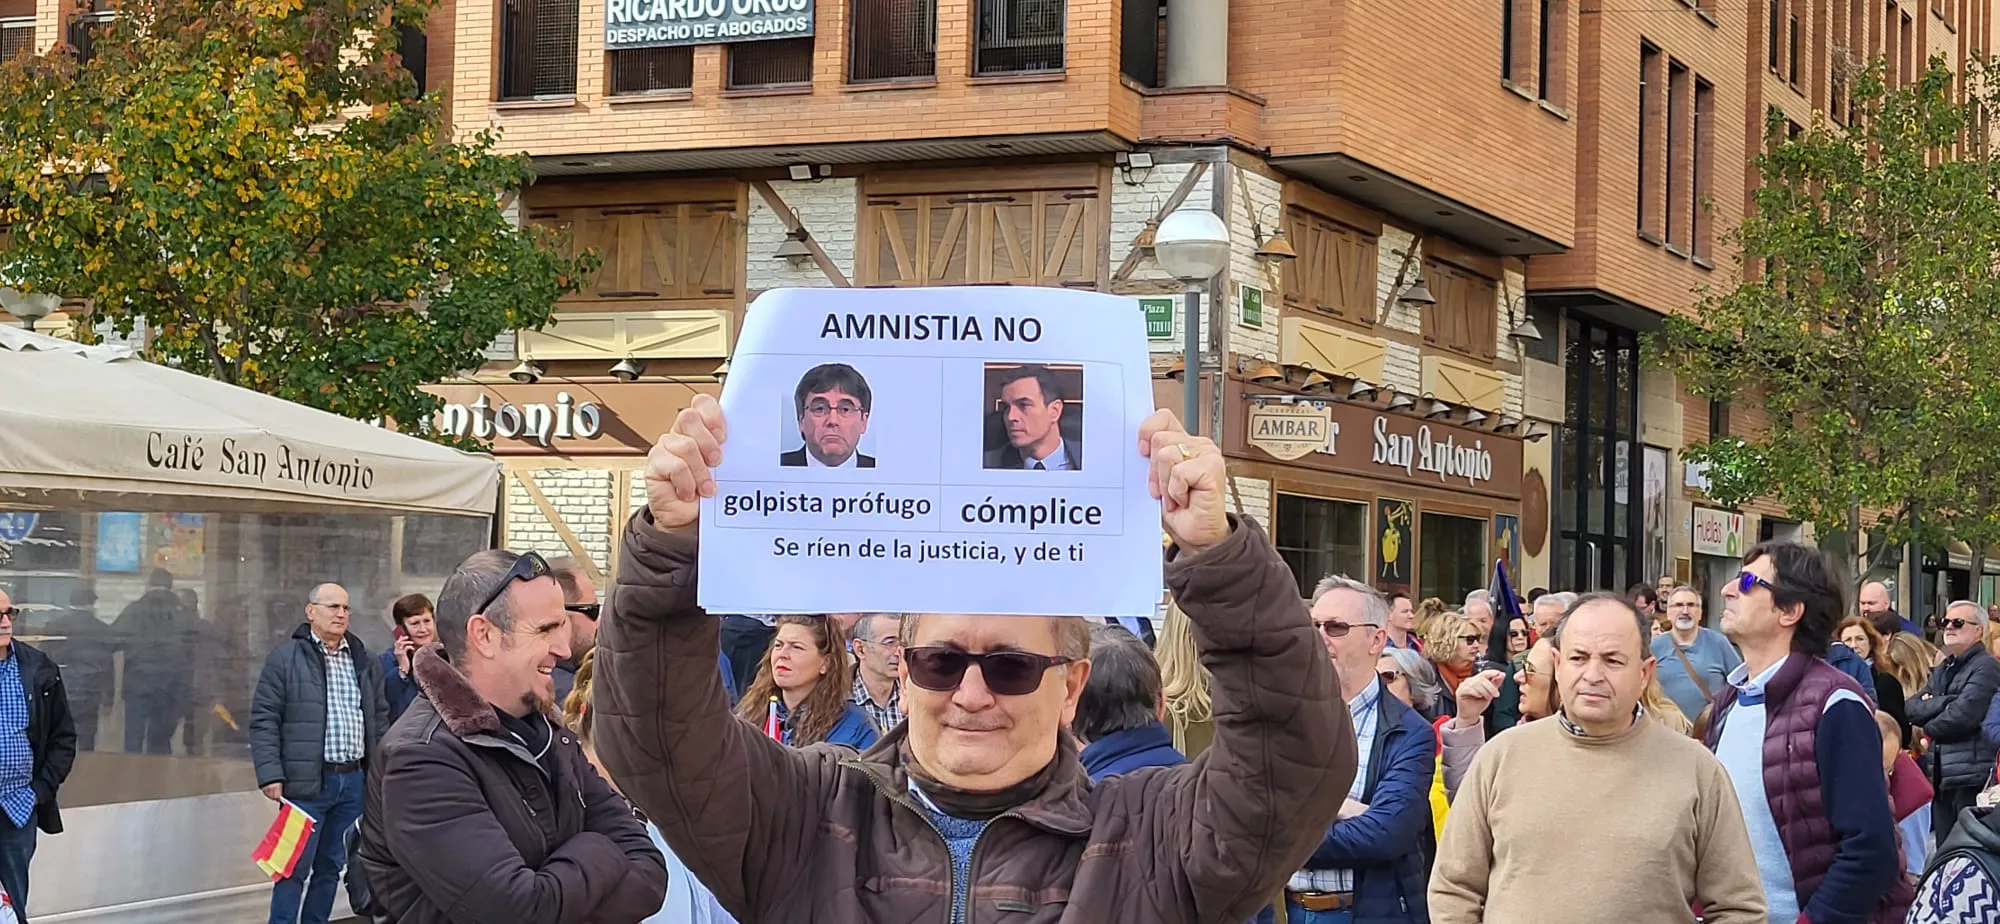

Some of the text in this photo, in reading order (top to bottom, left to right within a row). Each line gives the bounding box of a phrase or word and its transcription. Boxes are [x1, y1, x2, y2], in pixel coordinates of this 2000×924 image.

[608, 0, 726, 23] RICARDO
[606, 16, 808, 44] DESPACHO DE ABOGADOS
[1143, 304, 1165, 314] Plaza
[820, 313, 1042, 343] AMNISTIA NO
[1258, 420, 1320, 437] AMBAR
[147, 431, 374, 494] Café San Antonio
[1372, 416, 1414, 477] San
[1417, 425, 1492, 487] Antonio
[723, 489, 931, 520] golpista prófugo
[961, 496, 1102, 531] cómplice
[773, 536, 1084, 565] Se ríen de la justicia, y de ti
